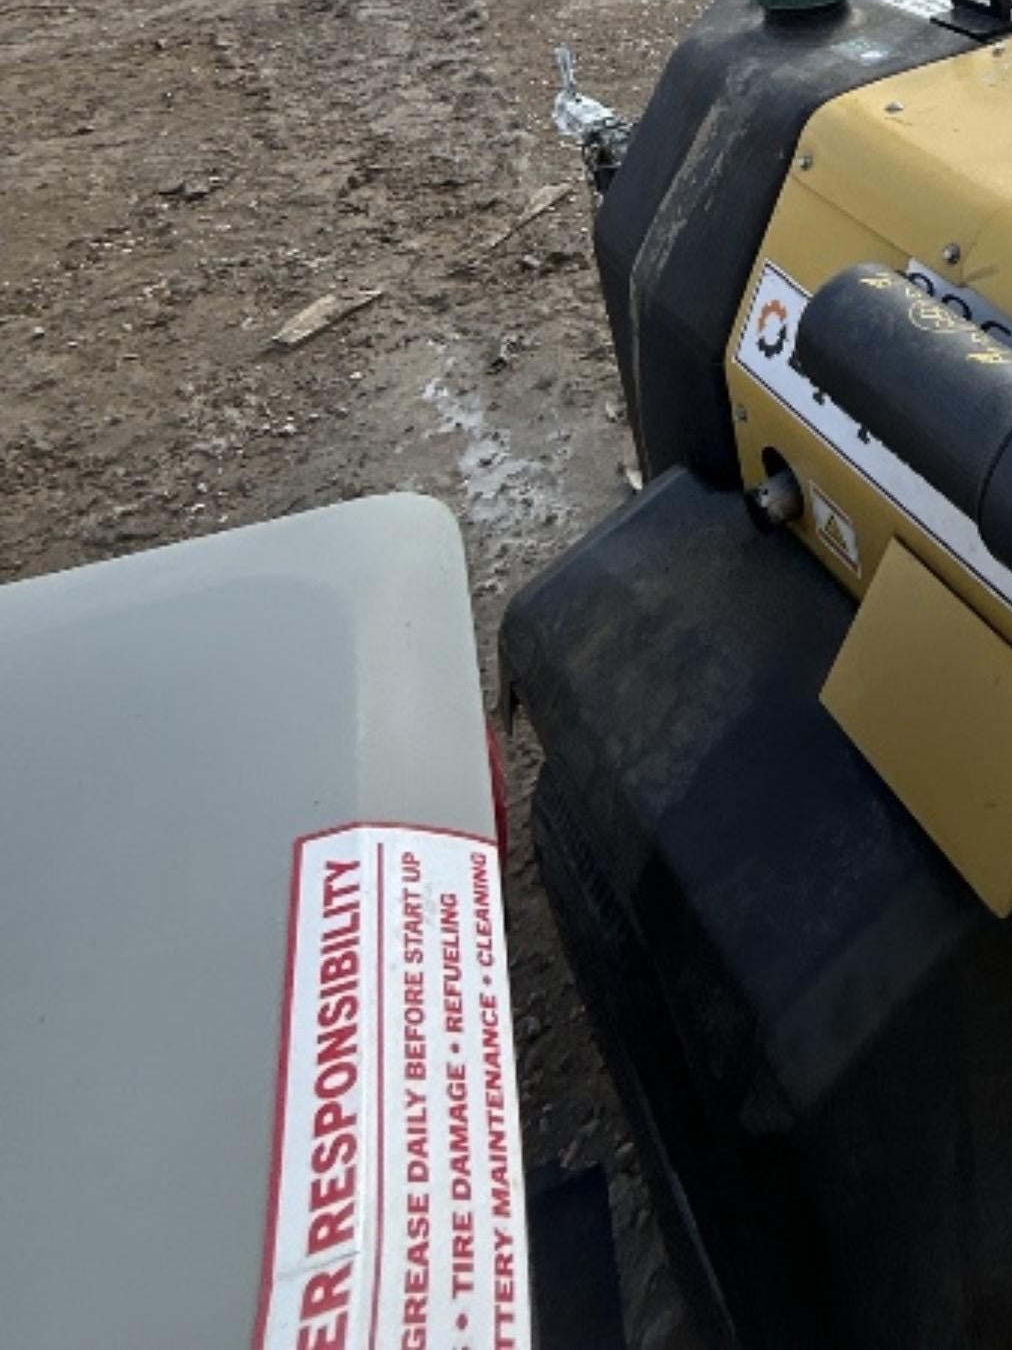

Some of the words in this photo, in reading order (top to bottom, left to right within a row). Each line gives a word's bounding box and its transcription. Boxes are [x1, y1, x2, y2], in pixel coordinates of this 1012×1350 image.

[402, 851, 421, 883] UP
[471, 852, 493, 967] CLEANING
[403, 887, 424, 964] START
[440, 892, 465, 1034] REFUELING
[307, 859, 361, 1257] RESPONSIBILITY
[404, 971, 427, 1080] BEFORE
[404, 1088, 430, 1183] DAILY
[446, 1061, 472, 1201] DAMAGE
[480, 992, 511, 1219] MAINTENANCE
[401, 1193, 430, 1350] GREASE
[452, 1211, 475, 1300] TIRE
